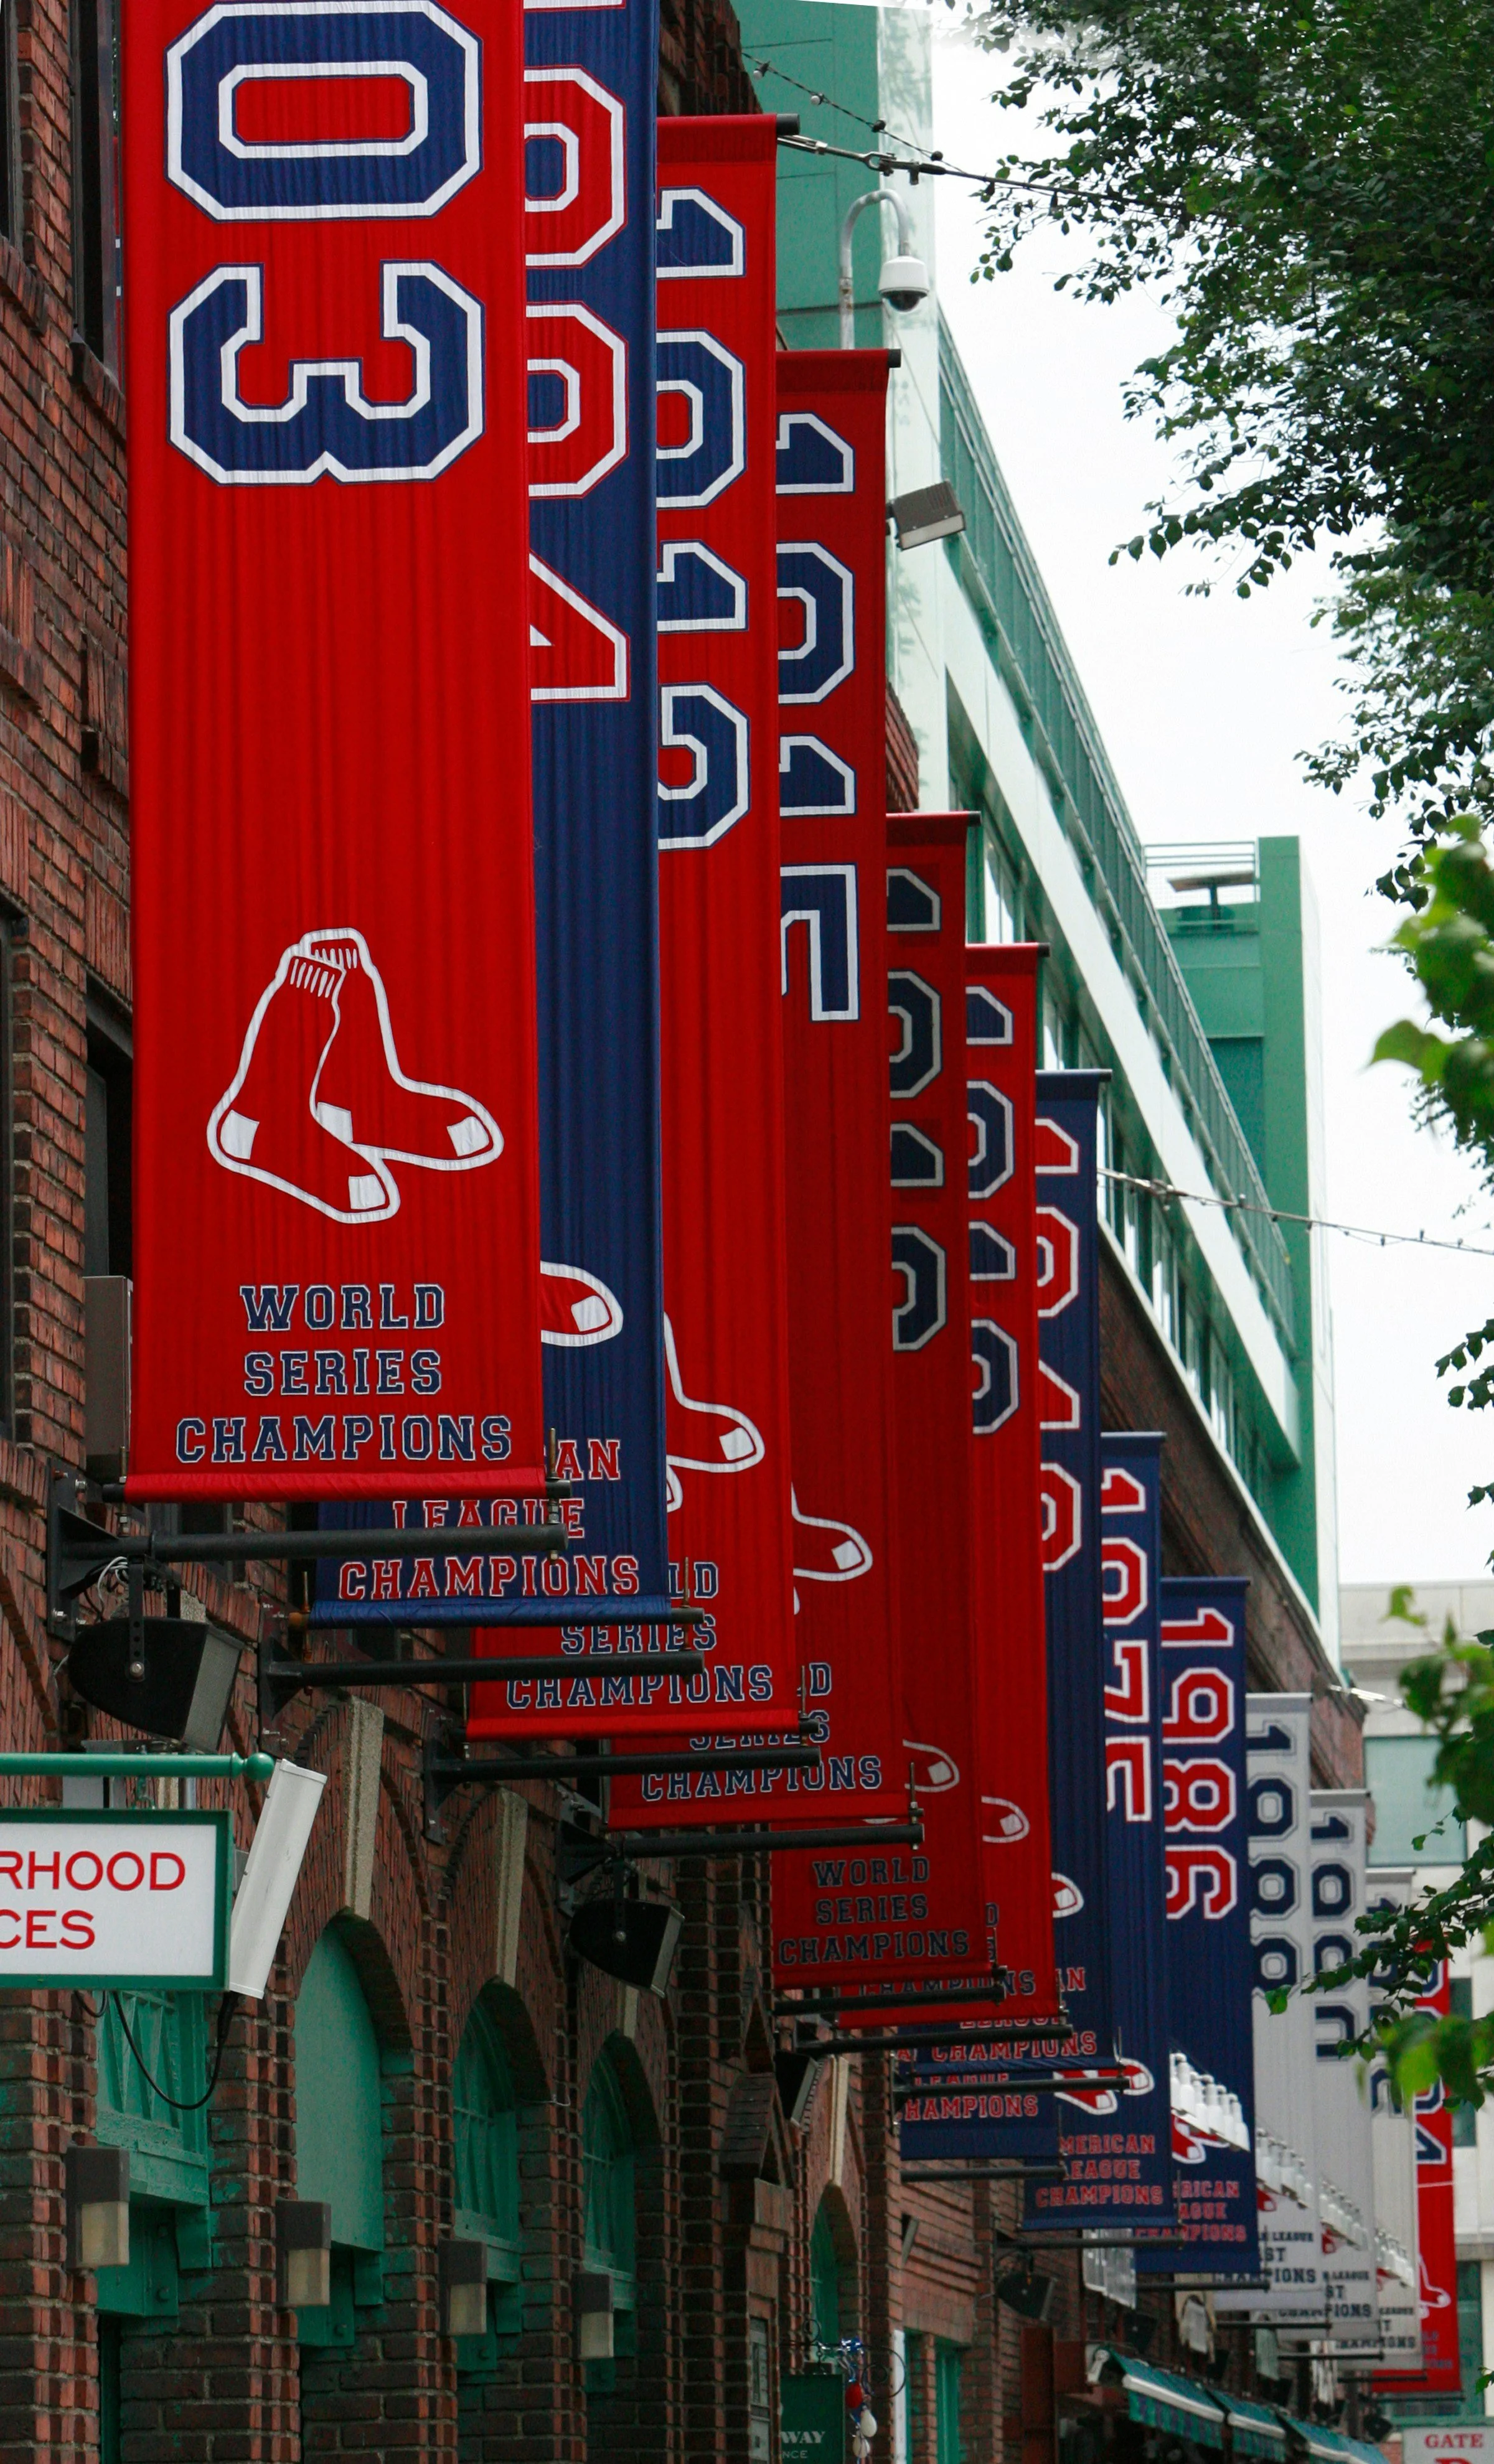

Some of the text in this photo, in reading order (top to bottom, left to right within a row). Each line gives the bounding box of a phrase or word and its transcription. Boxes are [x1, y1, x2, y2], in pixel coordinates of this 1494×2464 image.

[240, 1284, 445, 1331] WORLD
[243, 1349, 443, 1396] SERIES
[176, 1415, 512, 1463] CHAMPIONS
[339, 1555, 639, 1600] CHAMPIONS
[561, 1613, 717, 1654] SERIES
[506, 1664, 773, 1710] CHAMPIONS
[641, 1755, 882, 1802] CHAMPIONS
[812, 1856, 929, 1888] WORLD
[816, 1893, 929, 1925] SERIES
[779, 1930, 970, 1965] CHAMPIONS
[931, 2031, 1097, 2063] CHAMPIONS
[896, 2095, 1038, 2122] HAMPIONS
[1064, 2158, 1142, 2180] EAGUE
[1035, 2184, 1163, 2208] CHAMPIONS
[1424, 2433, 1483, 2448] GATE
